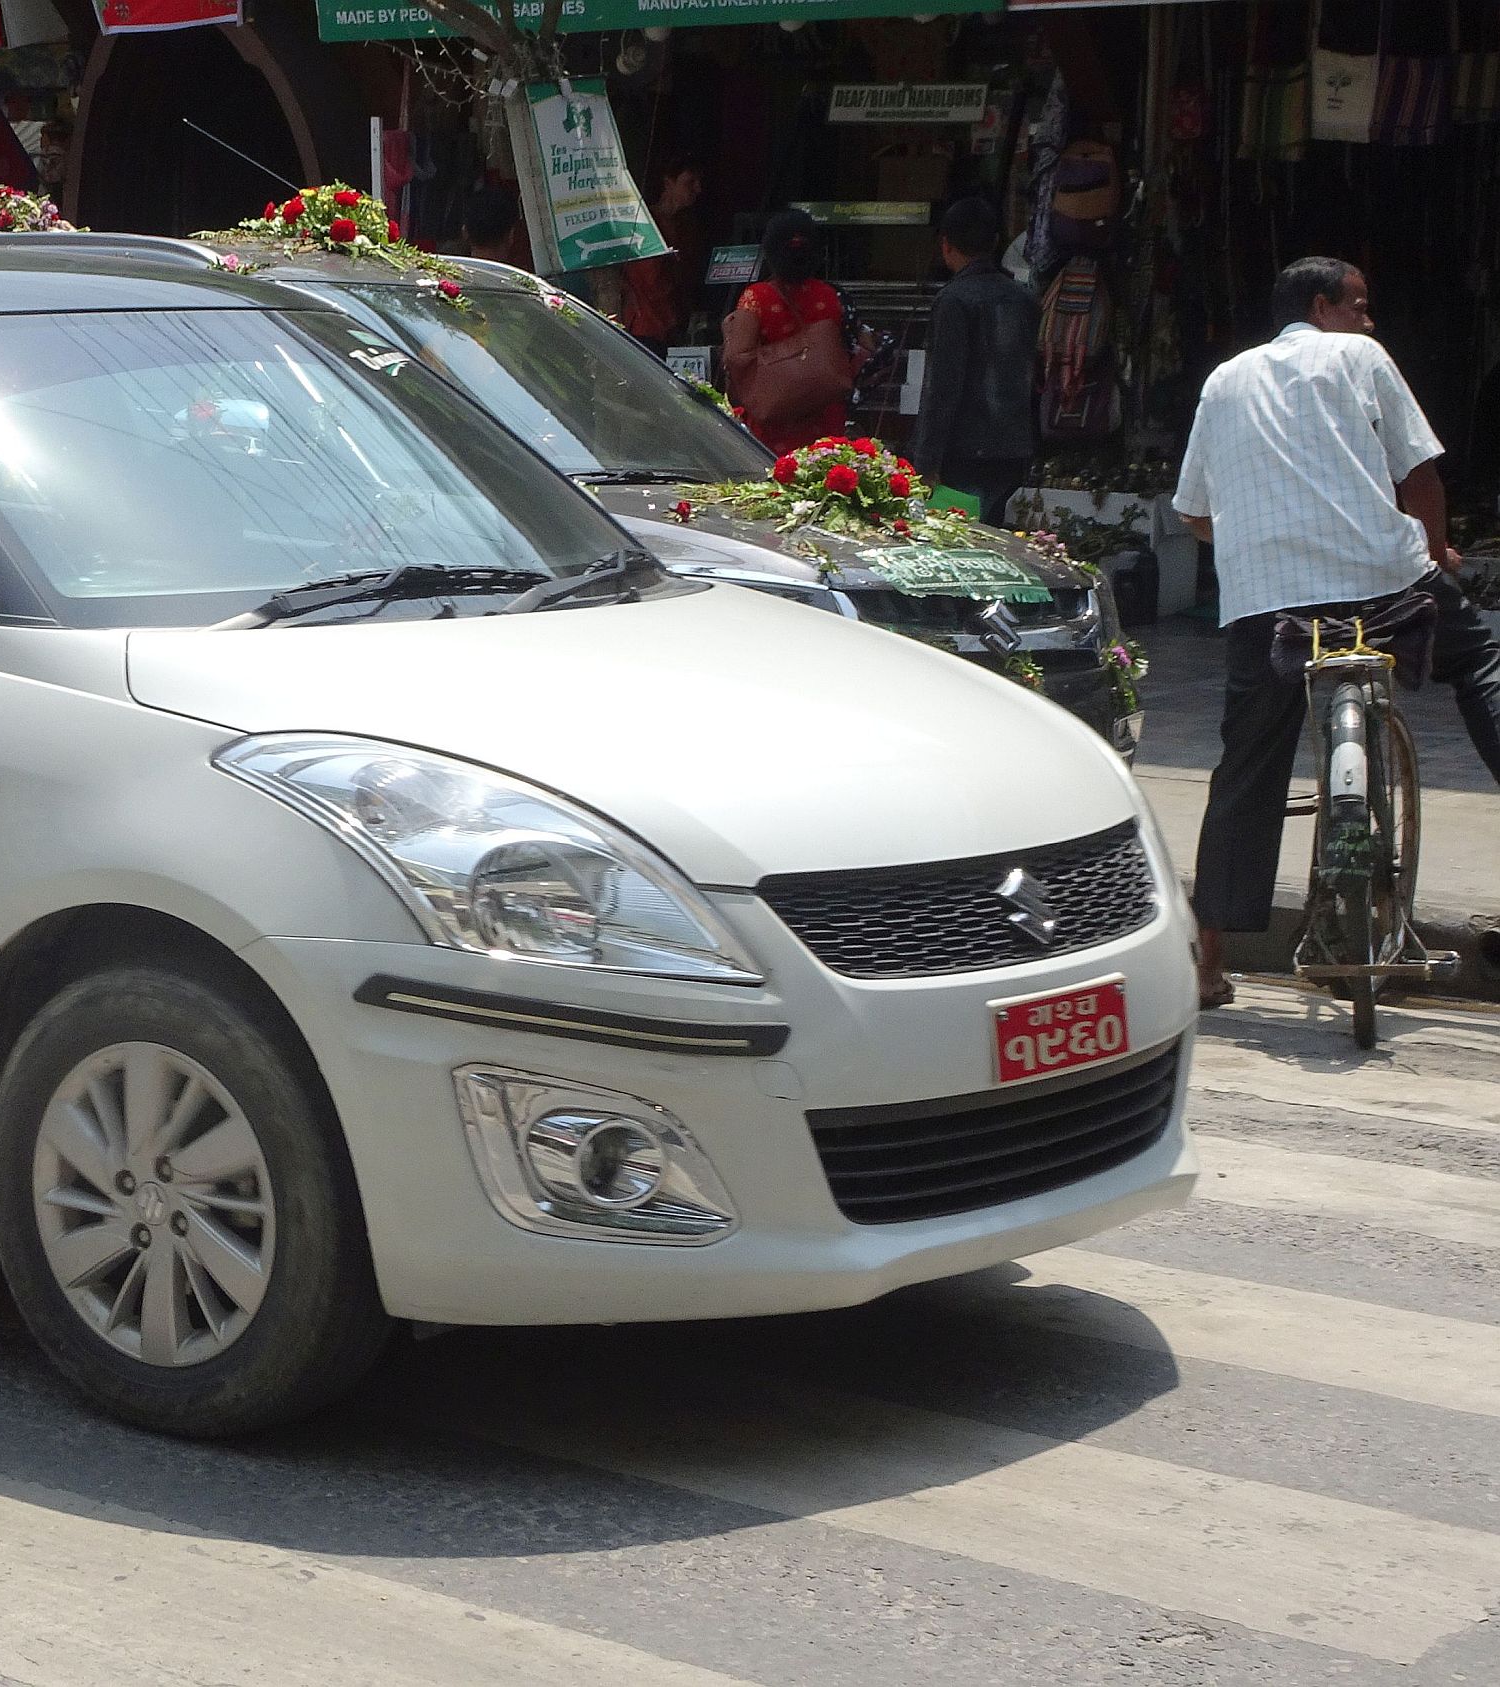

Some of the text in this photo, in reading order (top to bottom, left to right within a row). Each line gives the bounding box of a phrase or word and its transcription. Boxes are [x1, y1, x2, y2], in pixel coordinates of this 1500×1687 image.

[336, 10, 375, 25] MADE
[378, 9, 397, 22] BY
[400, 7, 433, 22] PEO
